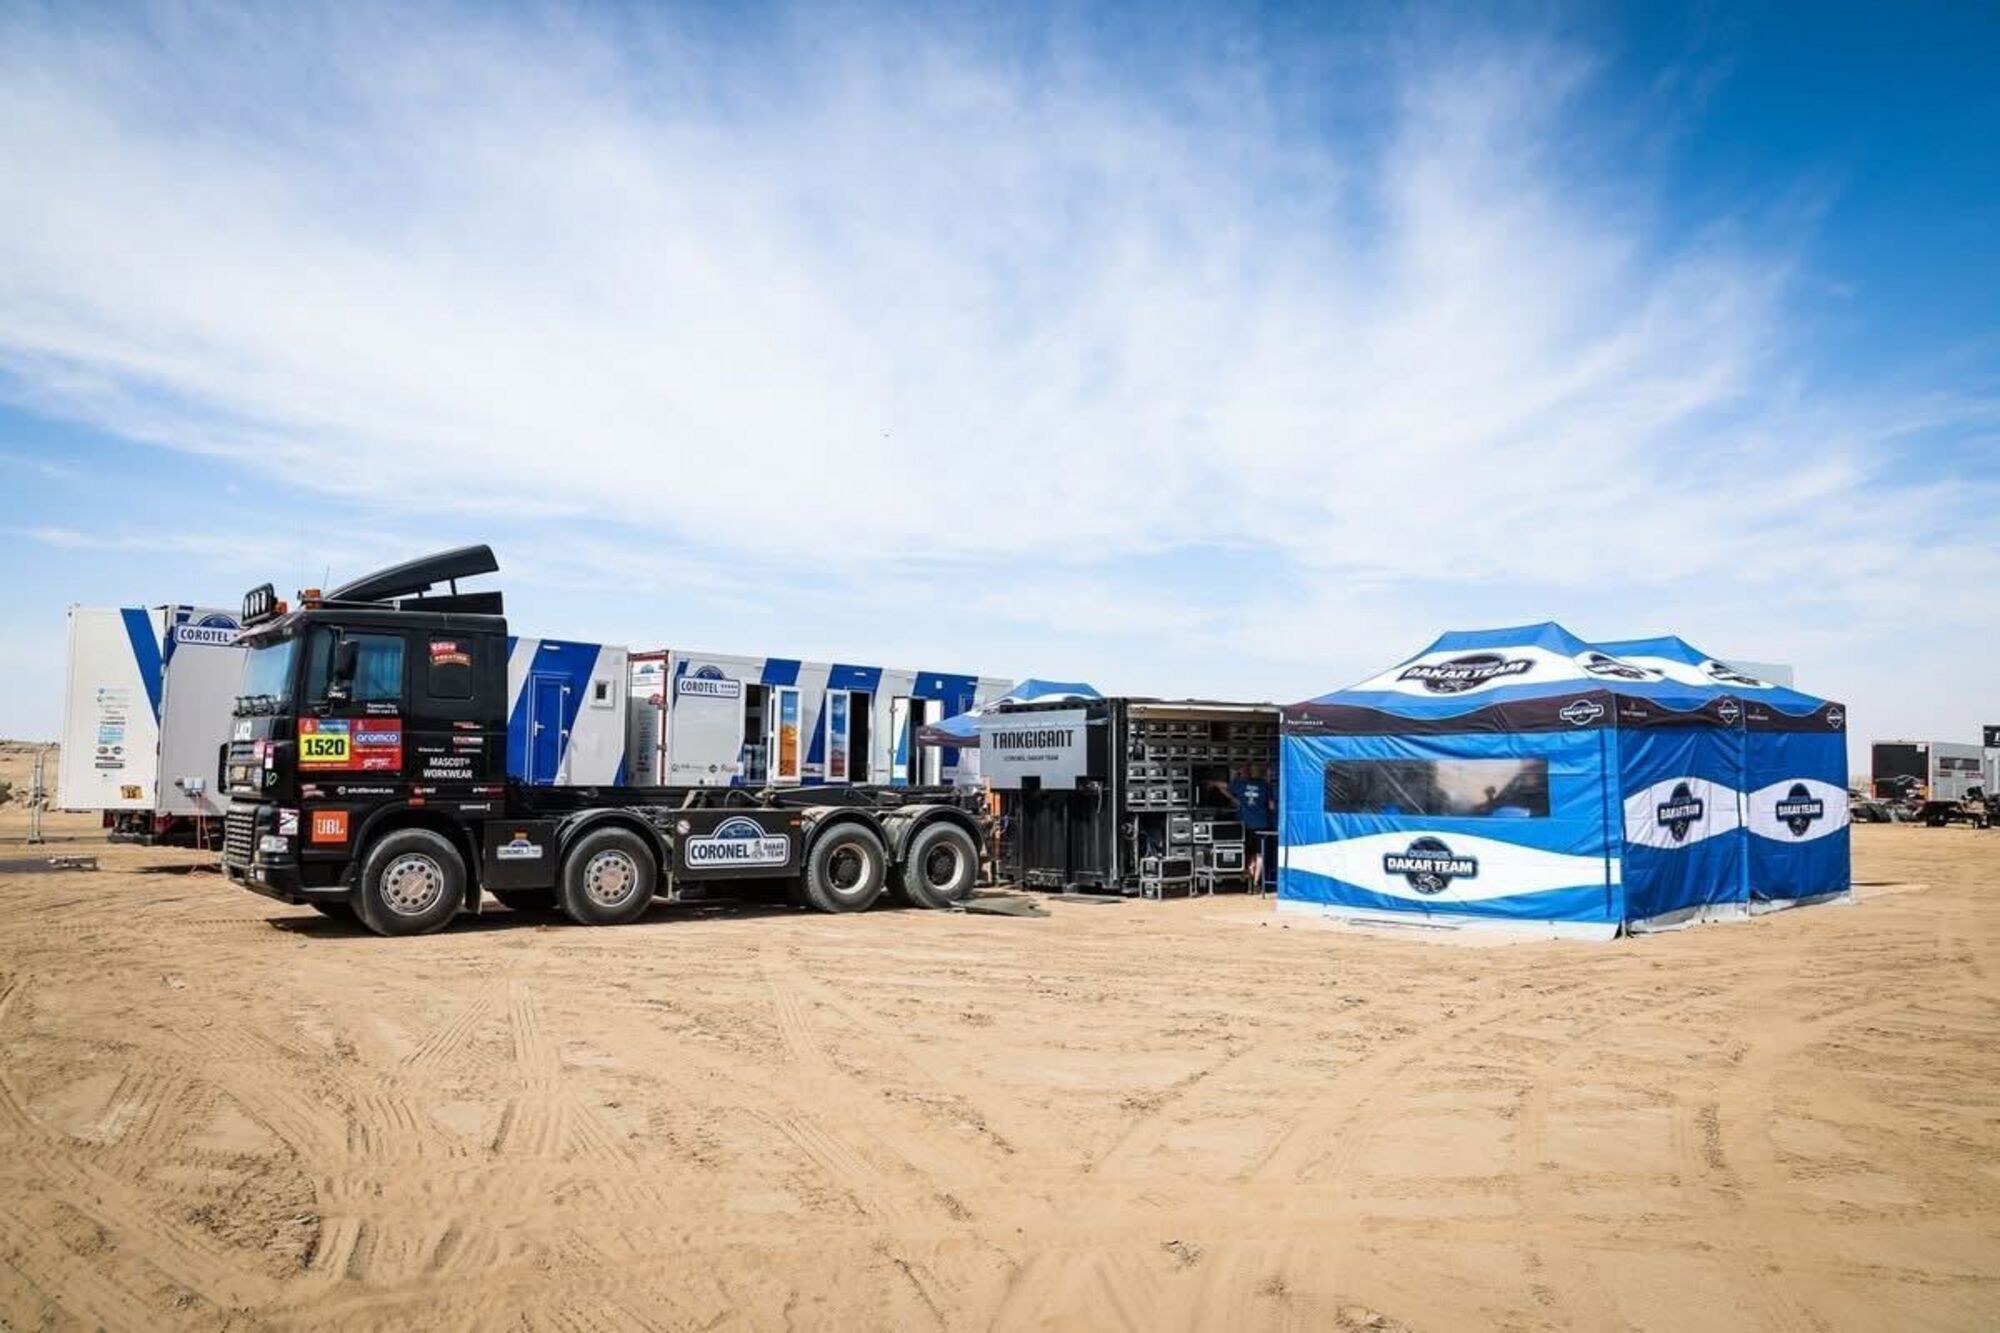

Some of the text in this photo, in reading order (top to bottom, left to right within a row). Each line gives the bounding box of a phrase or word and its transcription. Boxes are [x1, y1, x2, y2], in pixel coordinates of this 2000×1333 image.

[180, 628, 230, 642] COROTEL
[1404, 666, 1469, 679] DAKAR
[1469, 660, 1527, 677] TEAM
[681, 680, 719, 694] COROTEL
[356, 733, 398, 742] aramco
[991, 729, 1075, 749] TANKGIGANT
[304, 738, 345, 756] 1520
[422, 768, 473, 779] WORKWEAR
[691, 842, 785, 860] CORONEL DAKAR
[767, 850, 785, 858] TEAM
[1387, 857, 1473, 874] DAKAR TEAM
